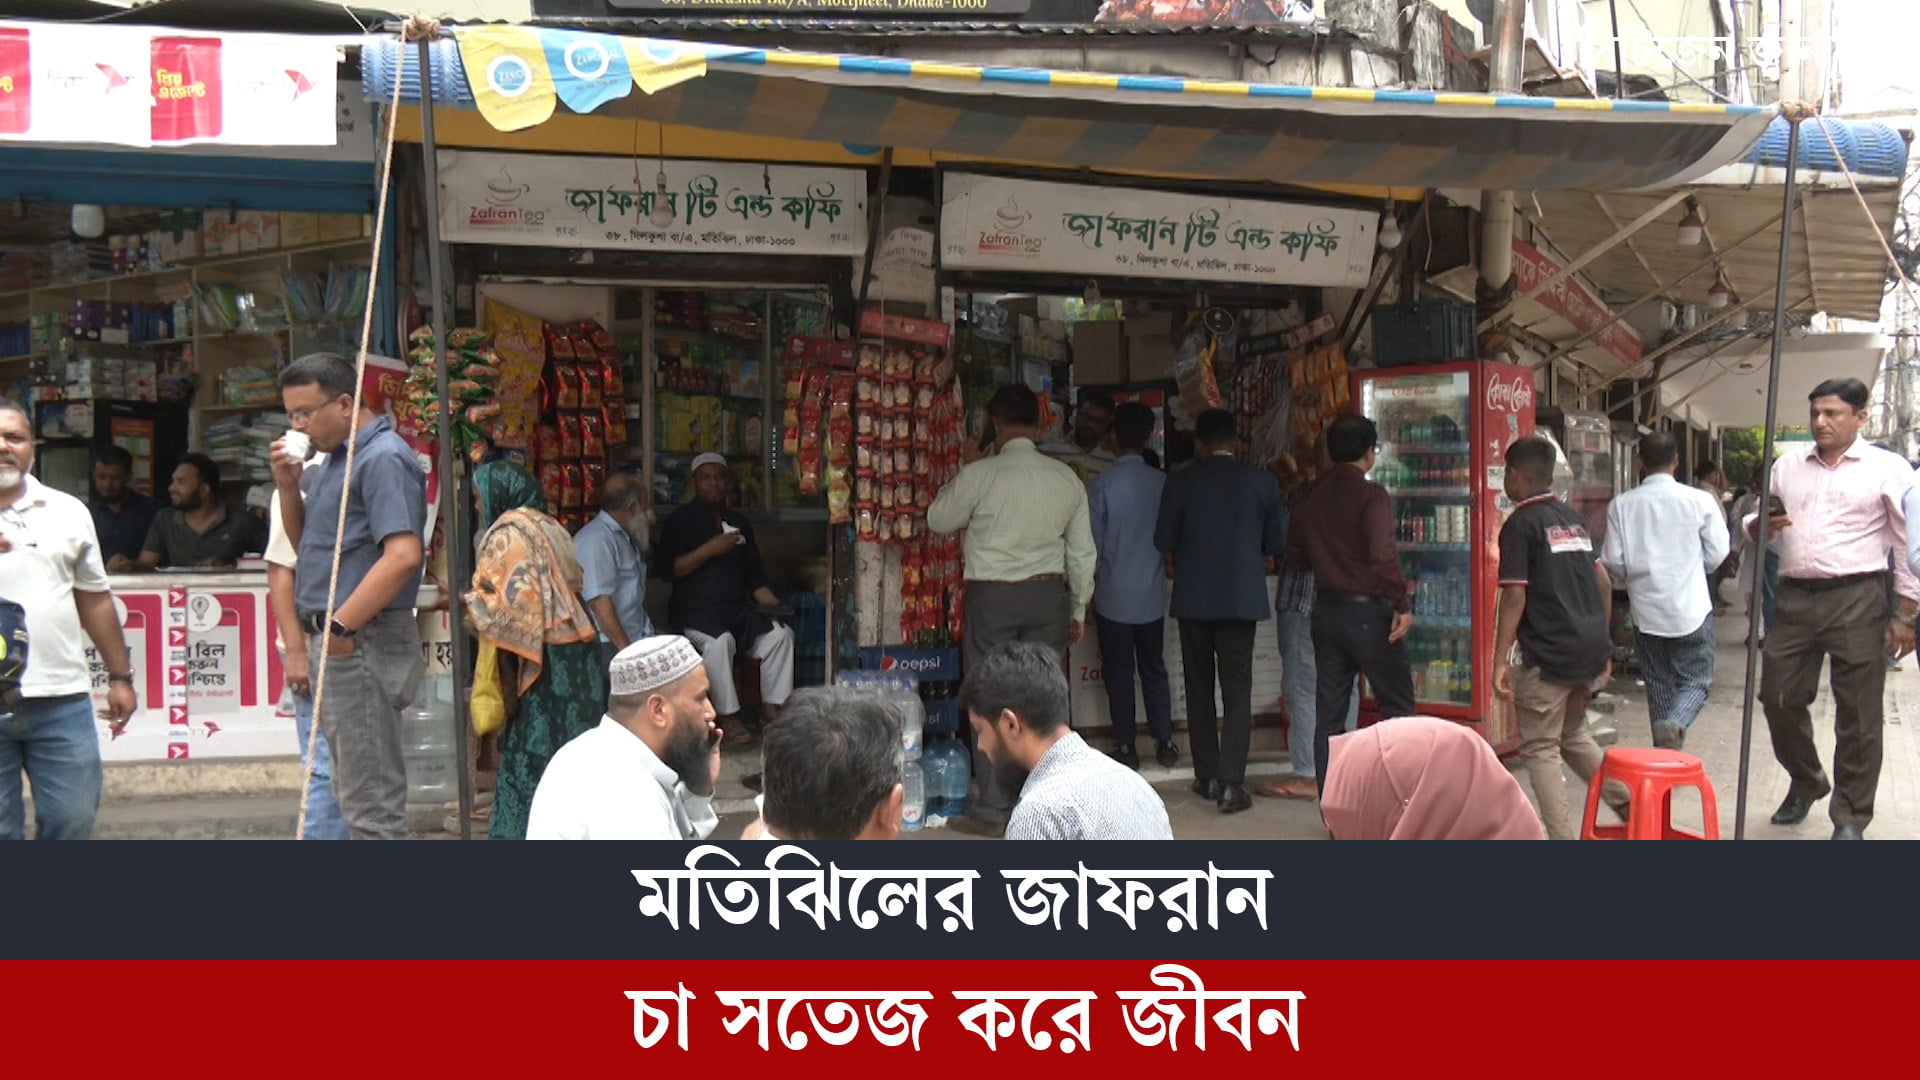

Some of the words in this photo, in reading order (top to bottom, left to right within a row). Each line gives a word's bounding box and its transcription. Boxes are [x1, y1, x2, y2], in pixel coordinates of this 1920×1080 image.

[897, 0, 988, 9] Dhaka-1000
[158, 80, 206, 100] এজেন্ট
[565, 184, 679, 223] জাফরান
[686, 174, 718, 225] টি
[725, 188, 774, 220] এন্ড
[781, 181, 843, 229] কফি
[469, 206, 545, 221] ZafranTea
[979, 231, 1042, 249] ZafranTea
[1062, 212, 1179, 250] জাফরান
[1184, 206, 1221, 254] টি
[1226, 220, 1273, 250] এন্ড
[1279, 217, 1341, 262] কফি
[196, 640, 226, 658] বিল
